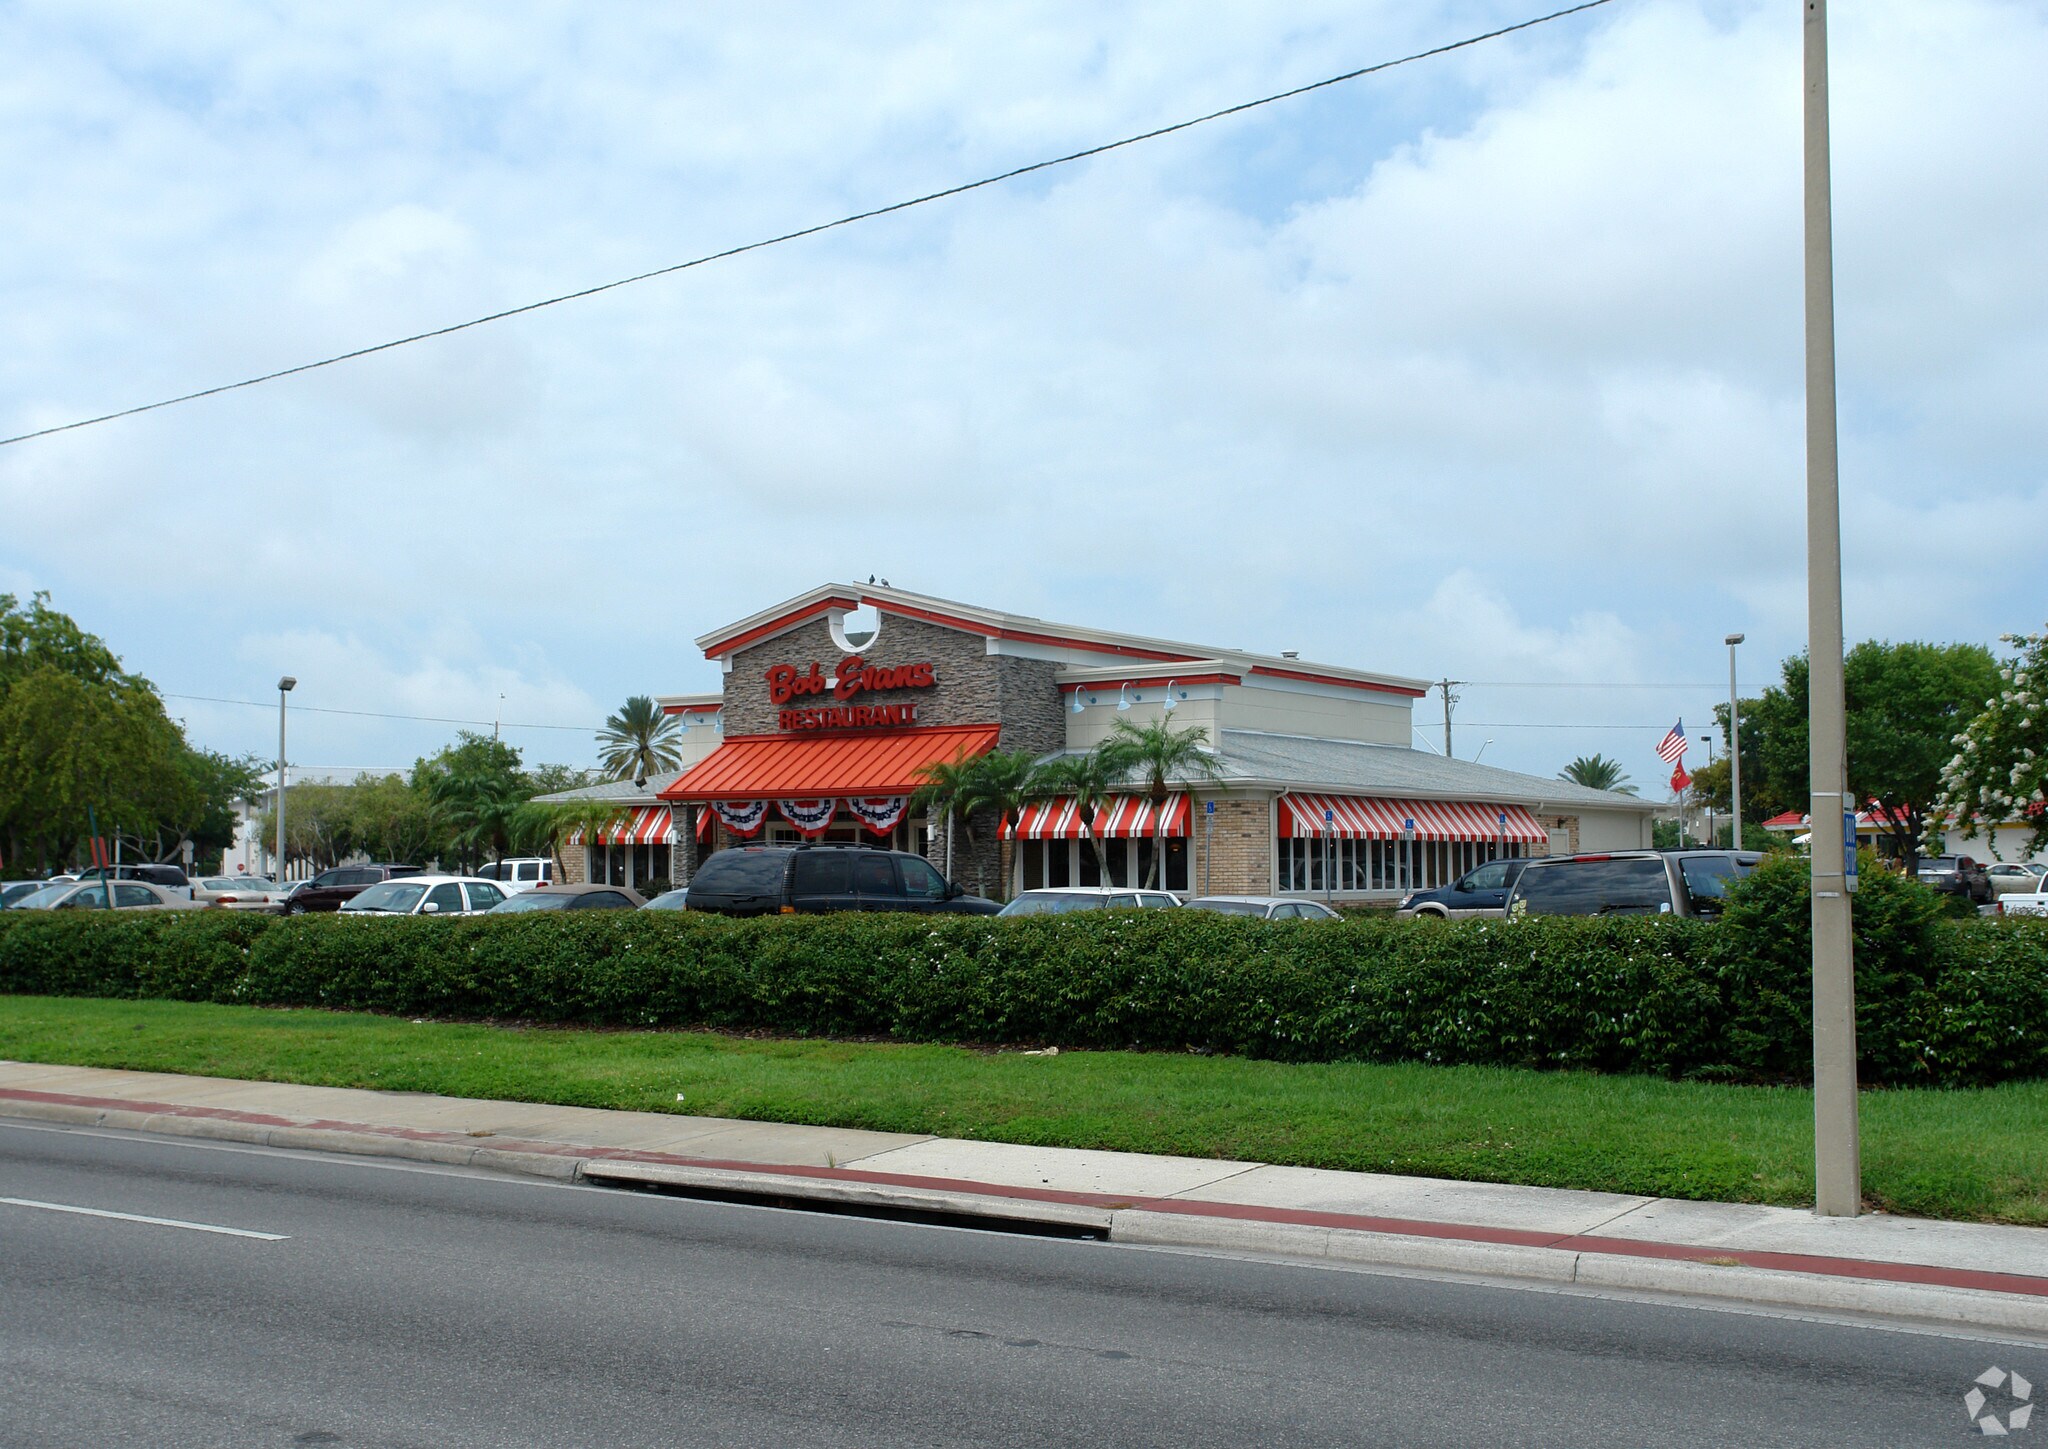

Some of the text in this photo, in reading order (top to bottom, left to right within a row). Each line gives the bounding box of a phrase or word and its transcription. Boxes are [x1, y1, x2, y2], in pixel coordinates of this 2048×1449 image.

[764, 655, 934, 705] Bob Evans
[778, 704, 918, 730] RESTAURANT
